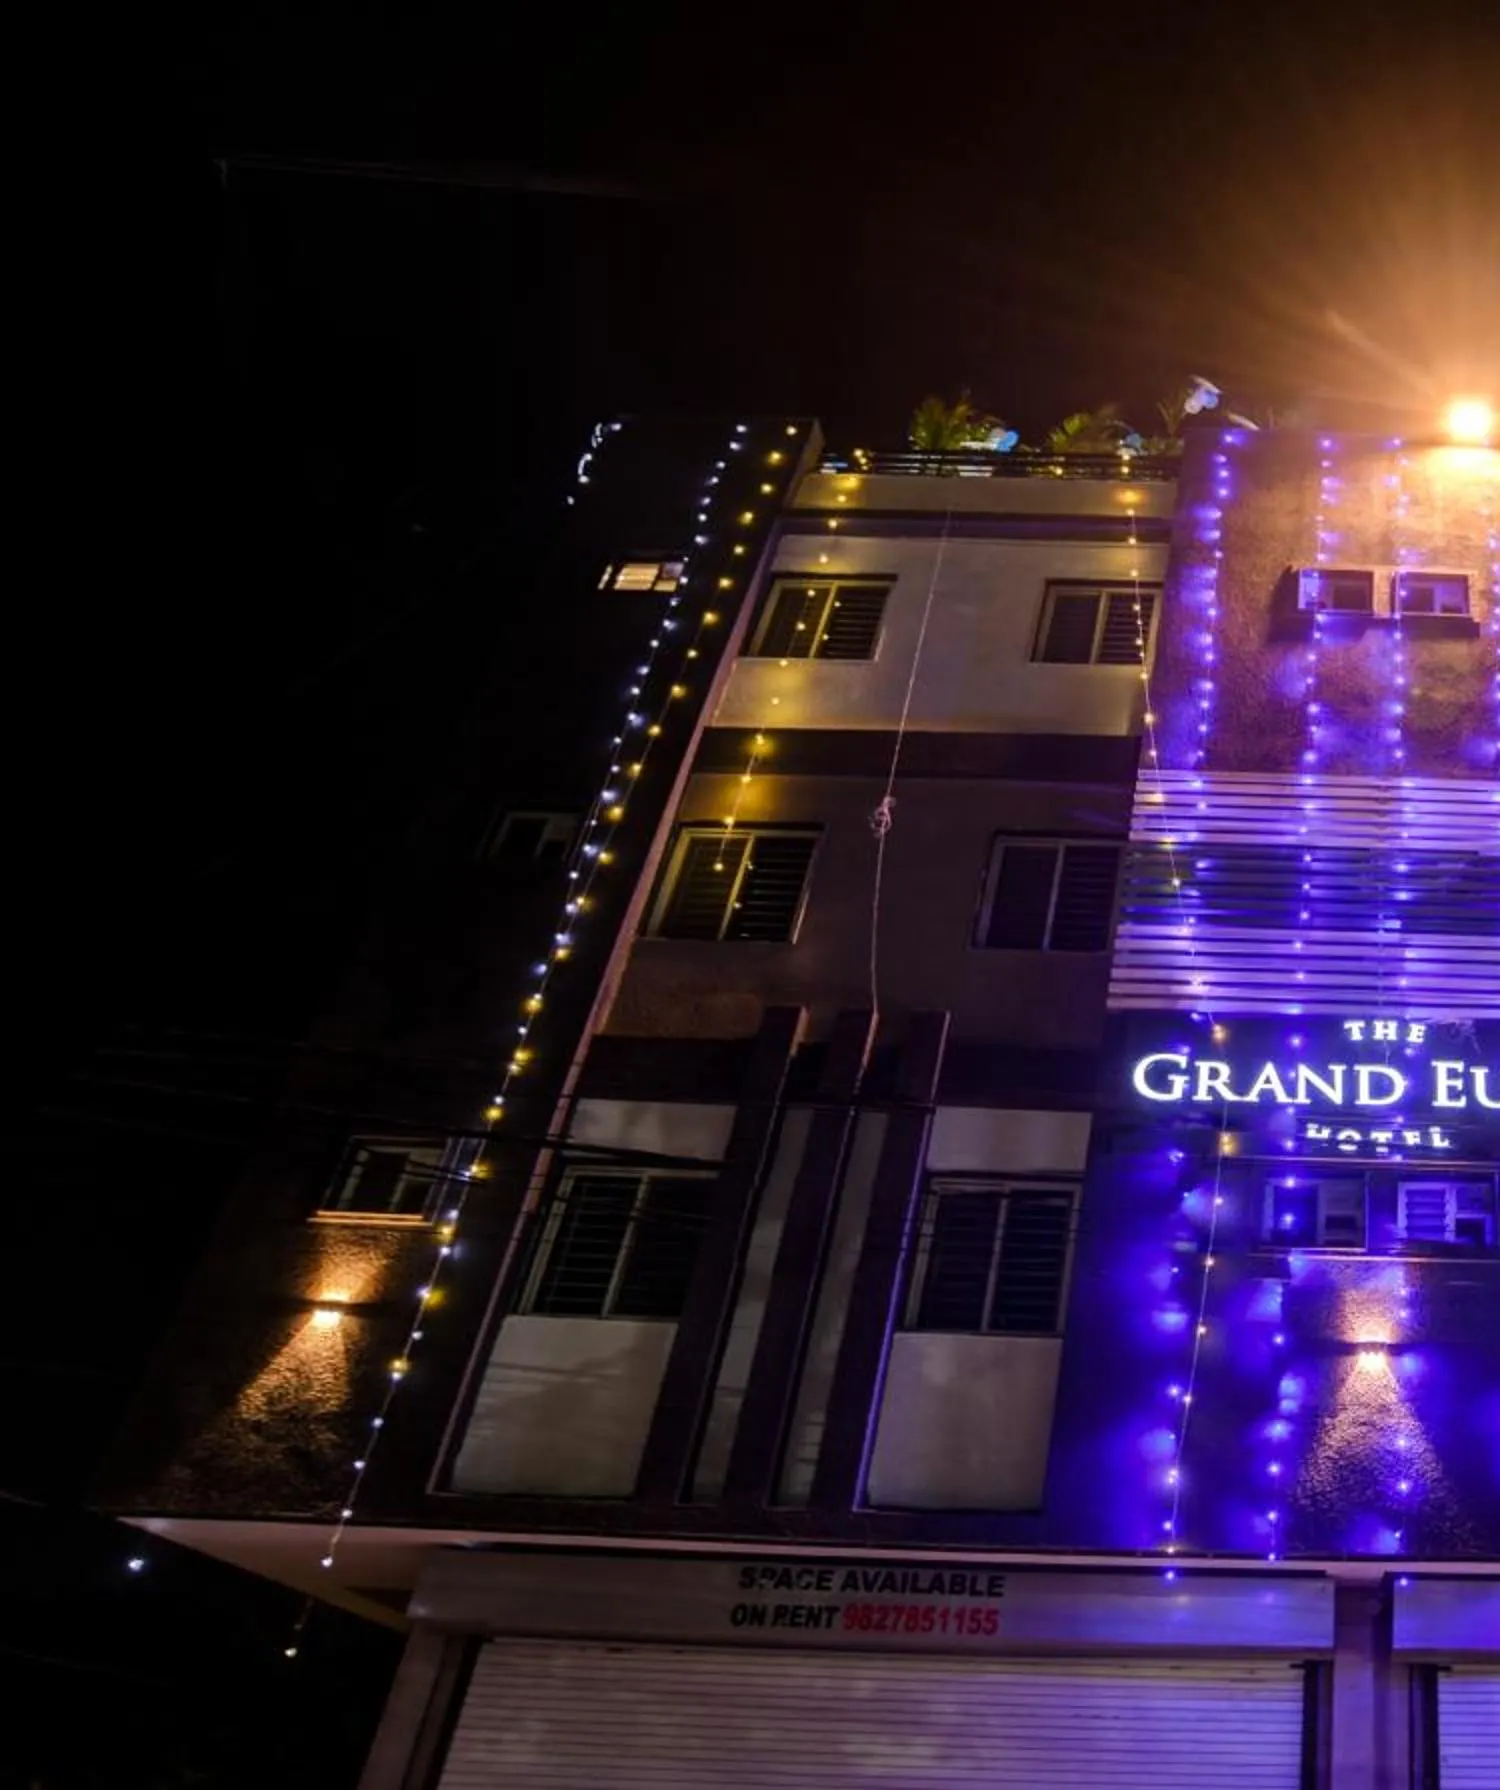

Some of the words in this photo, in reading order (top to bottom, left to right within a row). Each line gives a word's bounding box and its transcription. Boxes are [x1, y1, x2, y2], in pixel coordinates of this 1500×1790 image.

[1343, 1019, 1428, 1045] THE
[1132, 1052, 1407, 1107] GRAND
[738, 1565, 834, 1593] SPACE
[840, 1569, 1006, 1598] AVAILABLE
[730, 1602, 766, 1628] ON
[770, 1604, 841, 1630] RENT
[842, 1603, 1000, 1636] 9827851155
